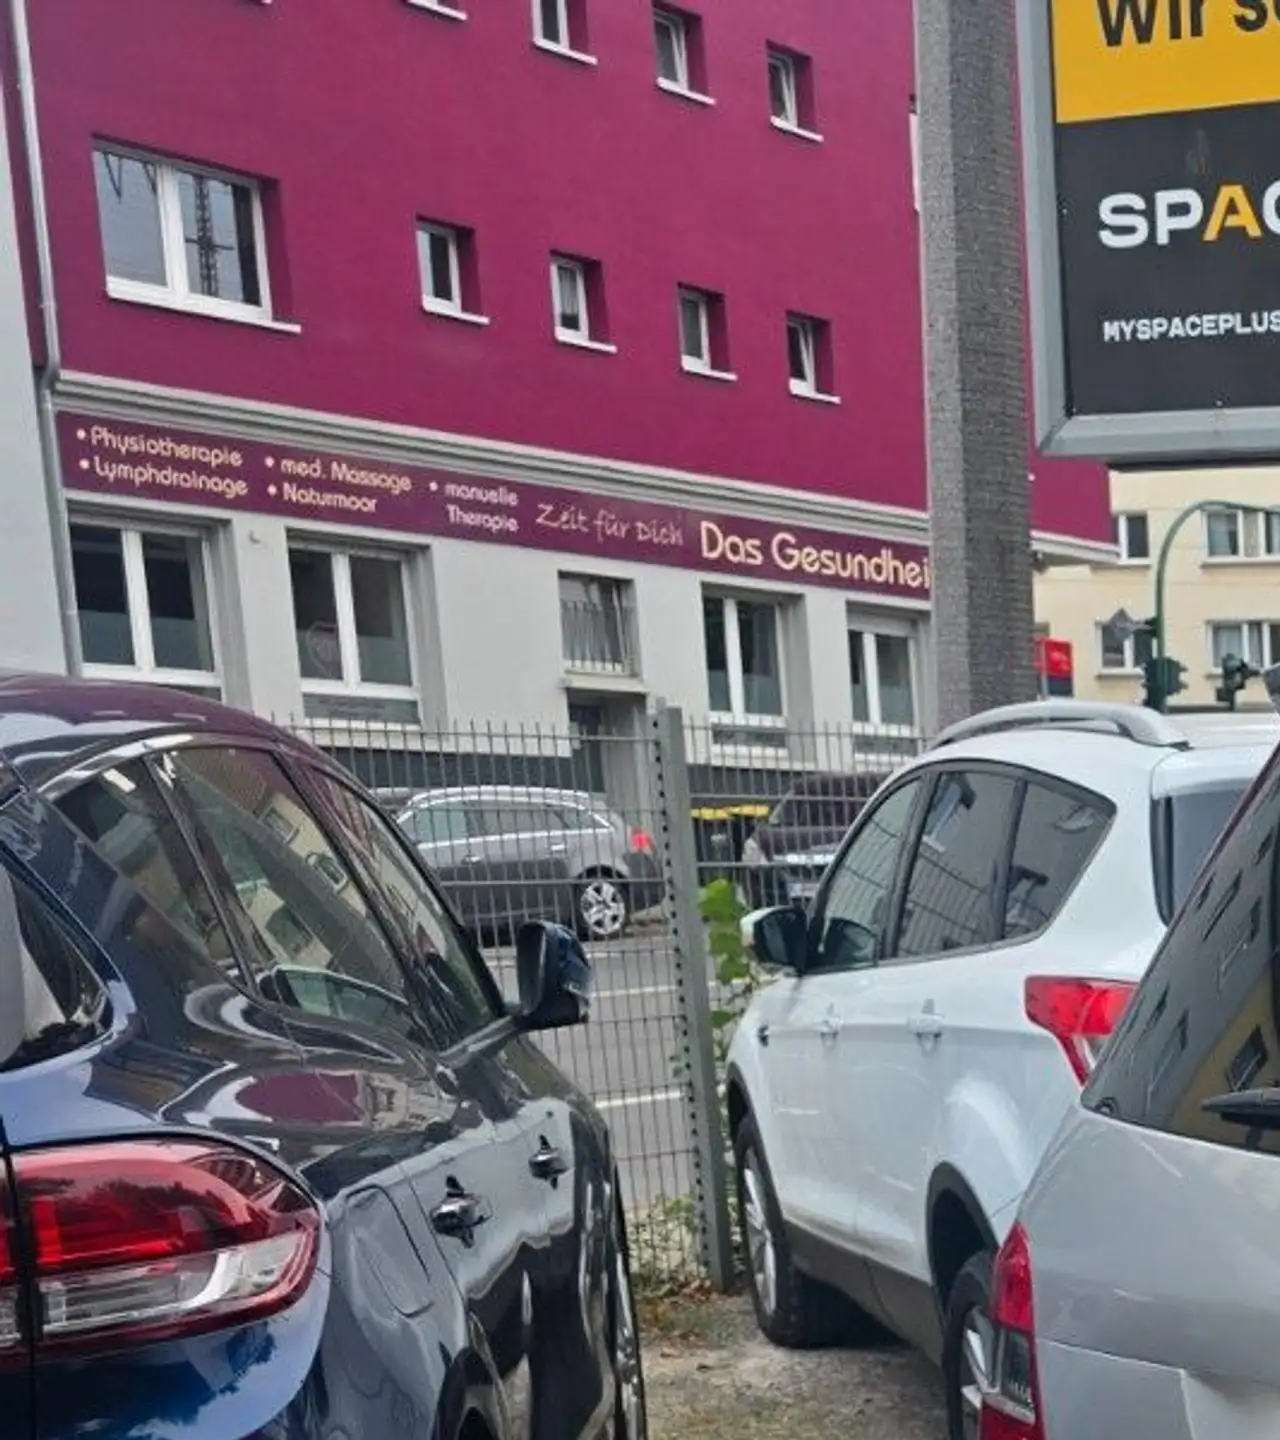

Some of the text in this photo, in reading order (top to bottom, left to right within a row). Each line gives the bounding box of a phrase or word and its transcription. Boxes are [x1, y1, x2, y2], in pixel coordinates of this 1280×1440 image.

[90, 425, 244, 467] Physiotherapie
[94, 456, 249, 499] Lymphdrainage
[281, 458, 413, 495] med. Massage
[444, 483, 519, 506] manuelle
[446, 504, 519, 533] Therapie
[536, 503, 588, 533] Zeit
[593, 509, 632, 543] für
[700, 520, 763, 567] Das
